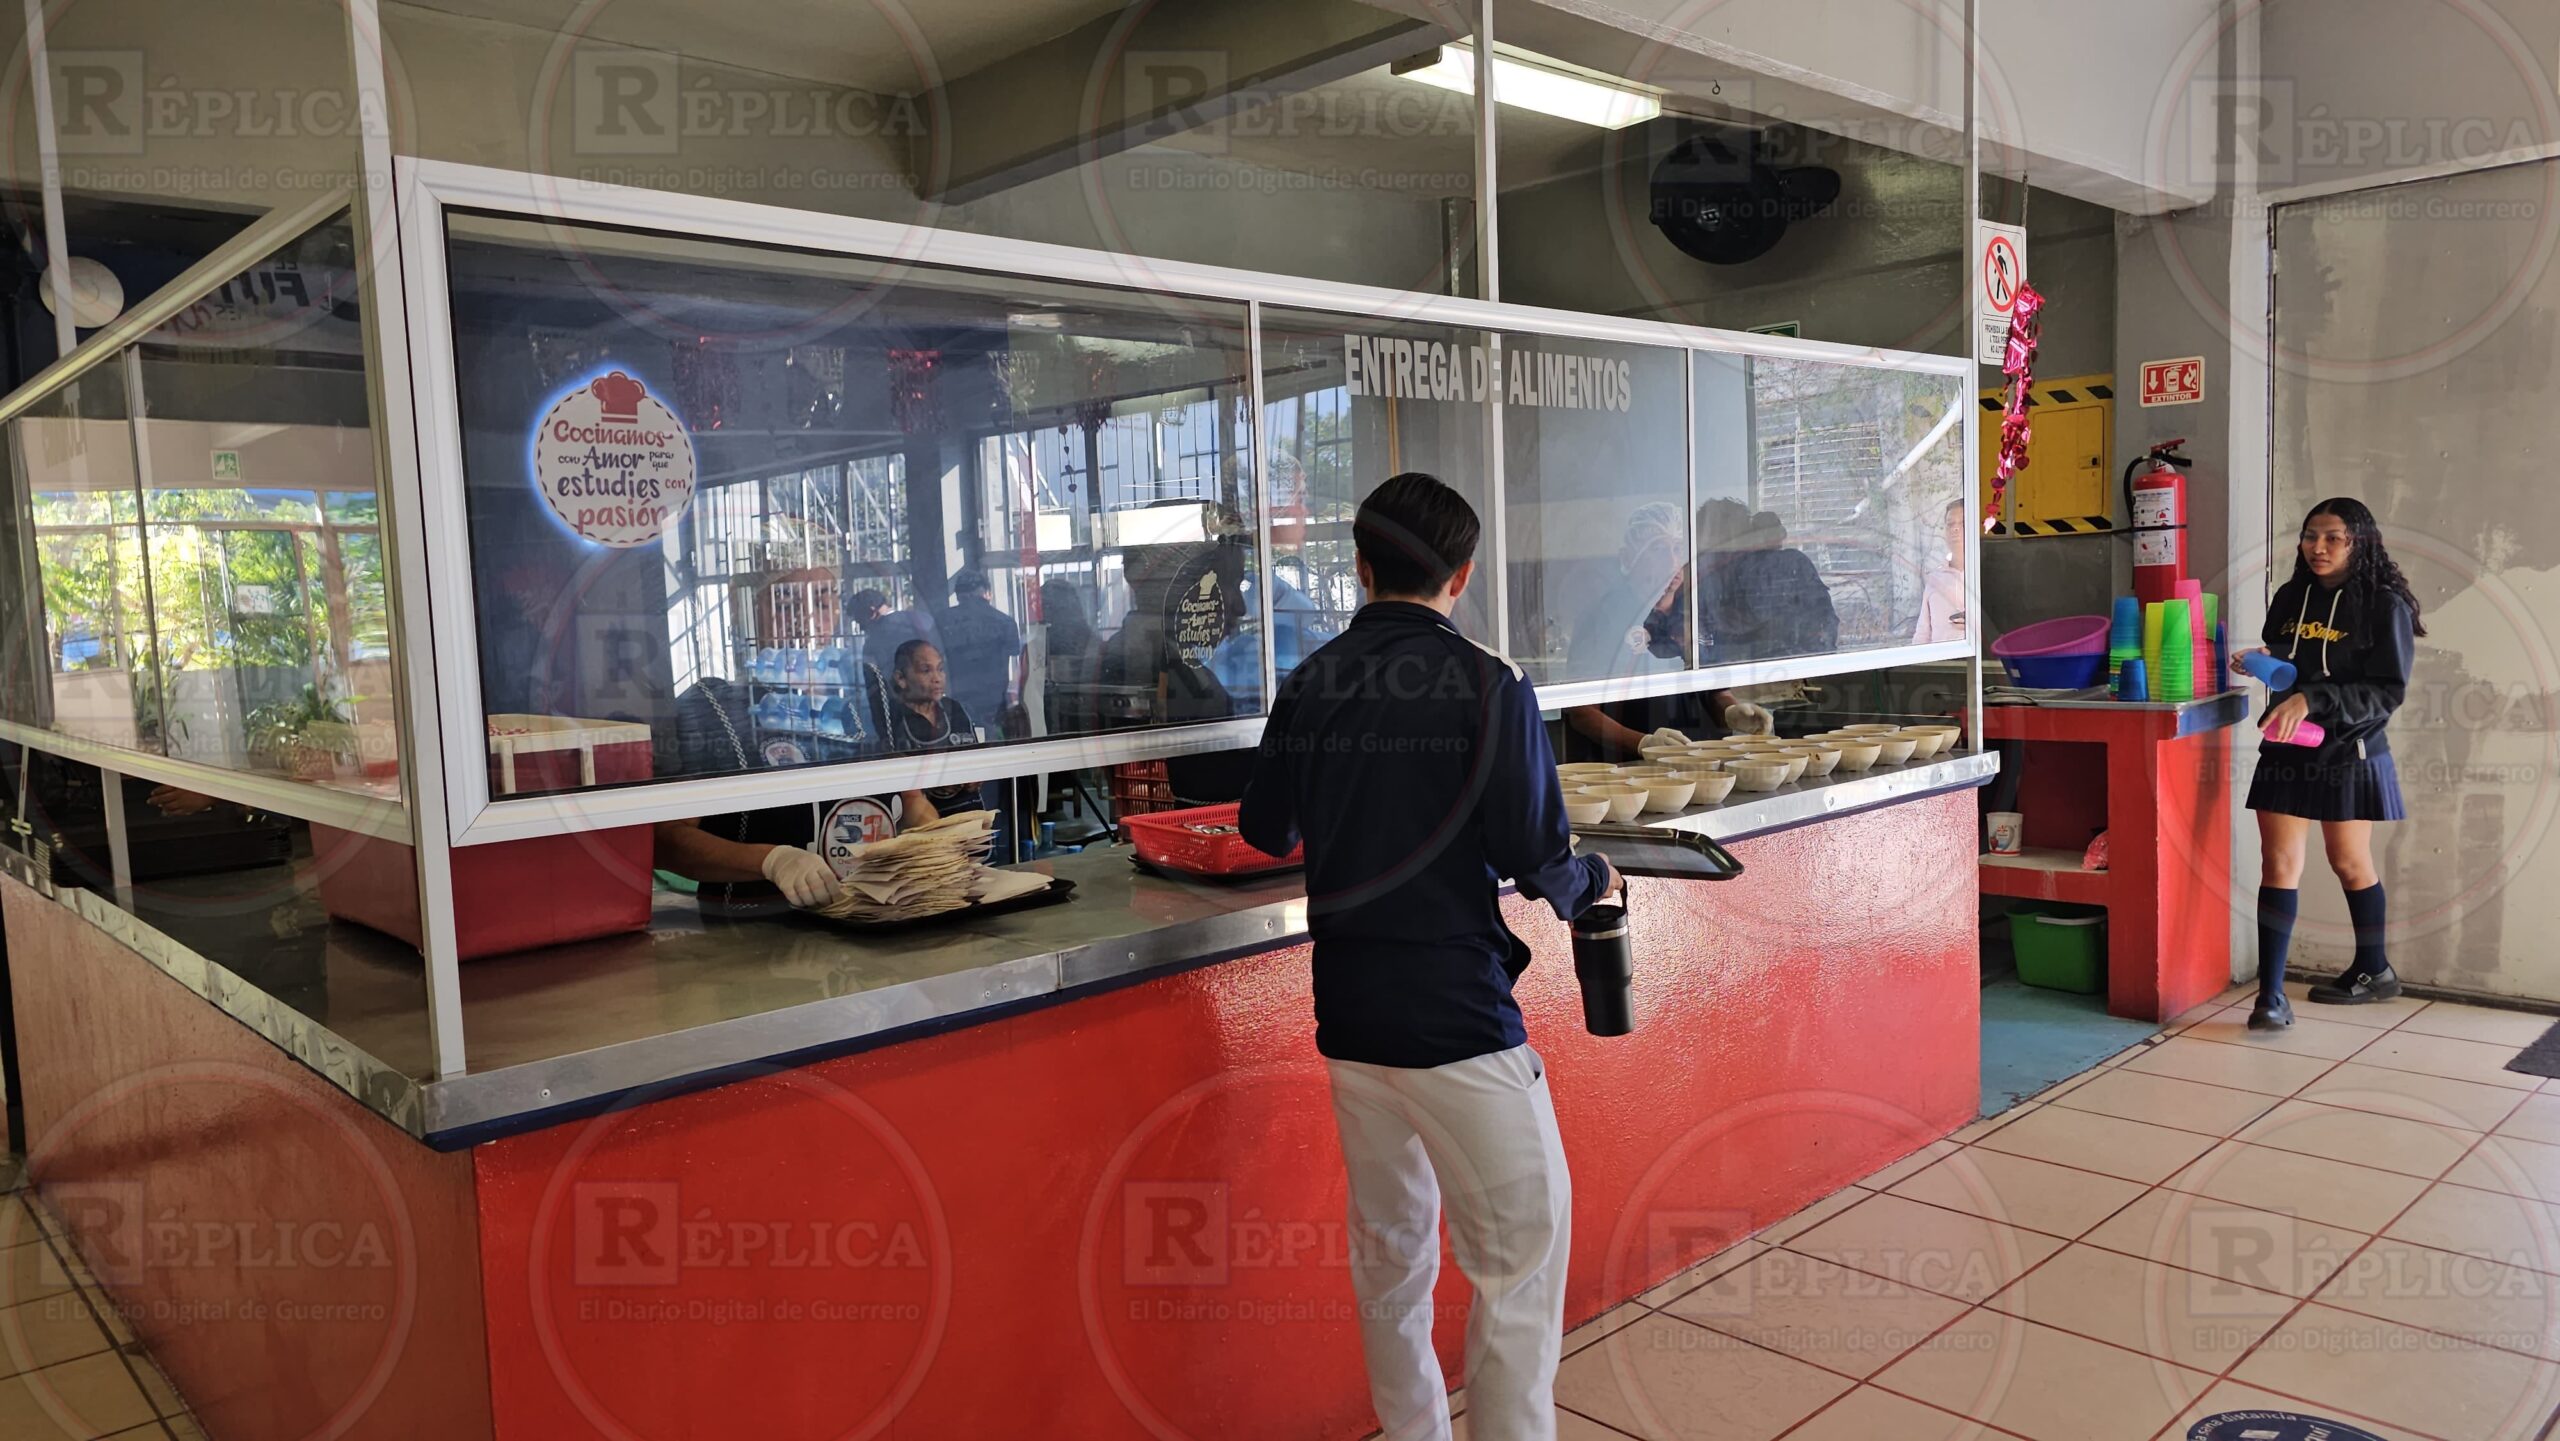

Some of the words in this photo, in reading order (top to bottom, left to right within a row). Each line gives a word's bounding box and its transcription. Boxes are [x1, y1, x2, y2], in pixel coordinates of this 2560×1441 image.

[1344, 334, 1465, 401] ENTREGA
[1471, 345, 1502, 403] DE
[1508, 350, 1631, 413] ALIMENTOS
[2151, 393, 2192, 403] EXTINTOR
[554, 420, 673, 448] Cocinamos
[558, 455, 580, 464] con
[582, 446, 645, 470] Amor
[649, 451, 674, 462] para
[652, 461, 669, 471] que
[557, 467, 660, 498] estudies
[665, 478, 686, 489] con
[577, 498, 669, 535] pasión
[2221, 1411, 2297, 1424] distancia
